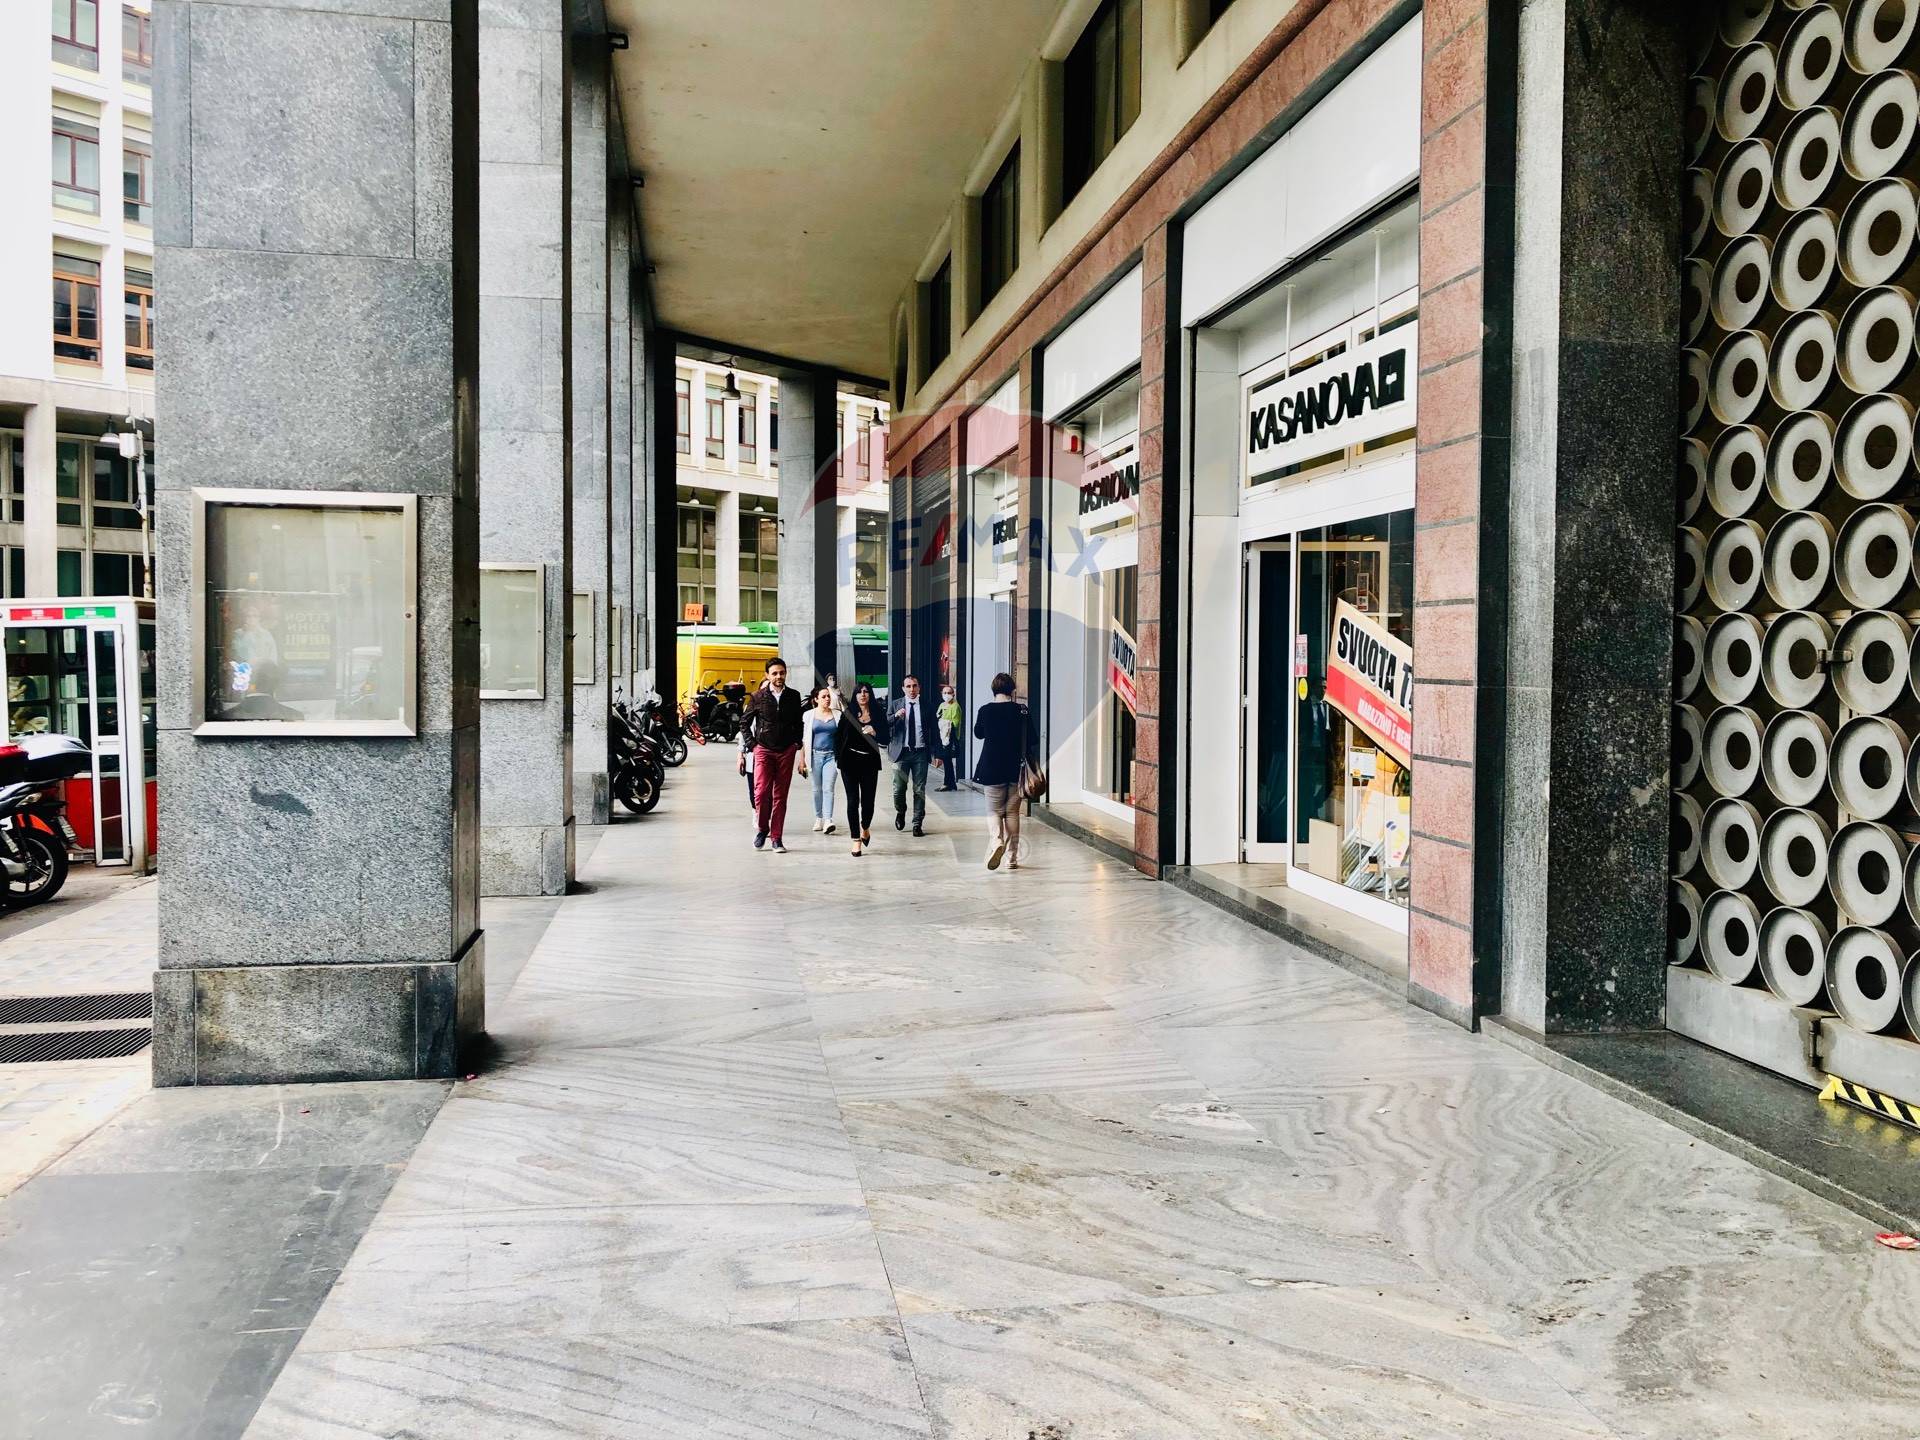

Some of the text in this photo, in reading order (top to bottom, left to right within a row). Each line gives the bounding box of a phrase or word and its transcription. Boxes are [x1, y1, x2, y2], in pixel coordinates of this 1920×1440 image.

[1249, 362, 1379, 454] KASANOVA
[687, 608, 702, 617] TAXI
[1337, 617, 1397, 699] SVUOTA
